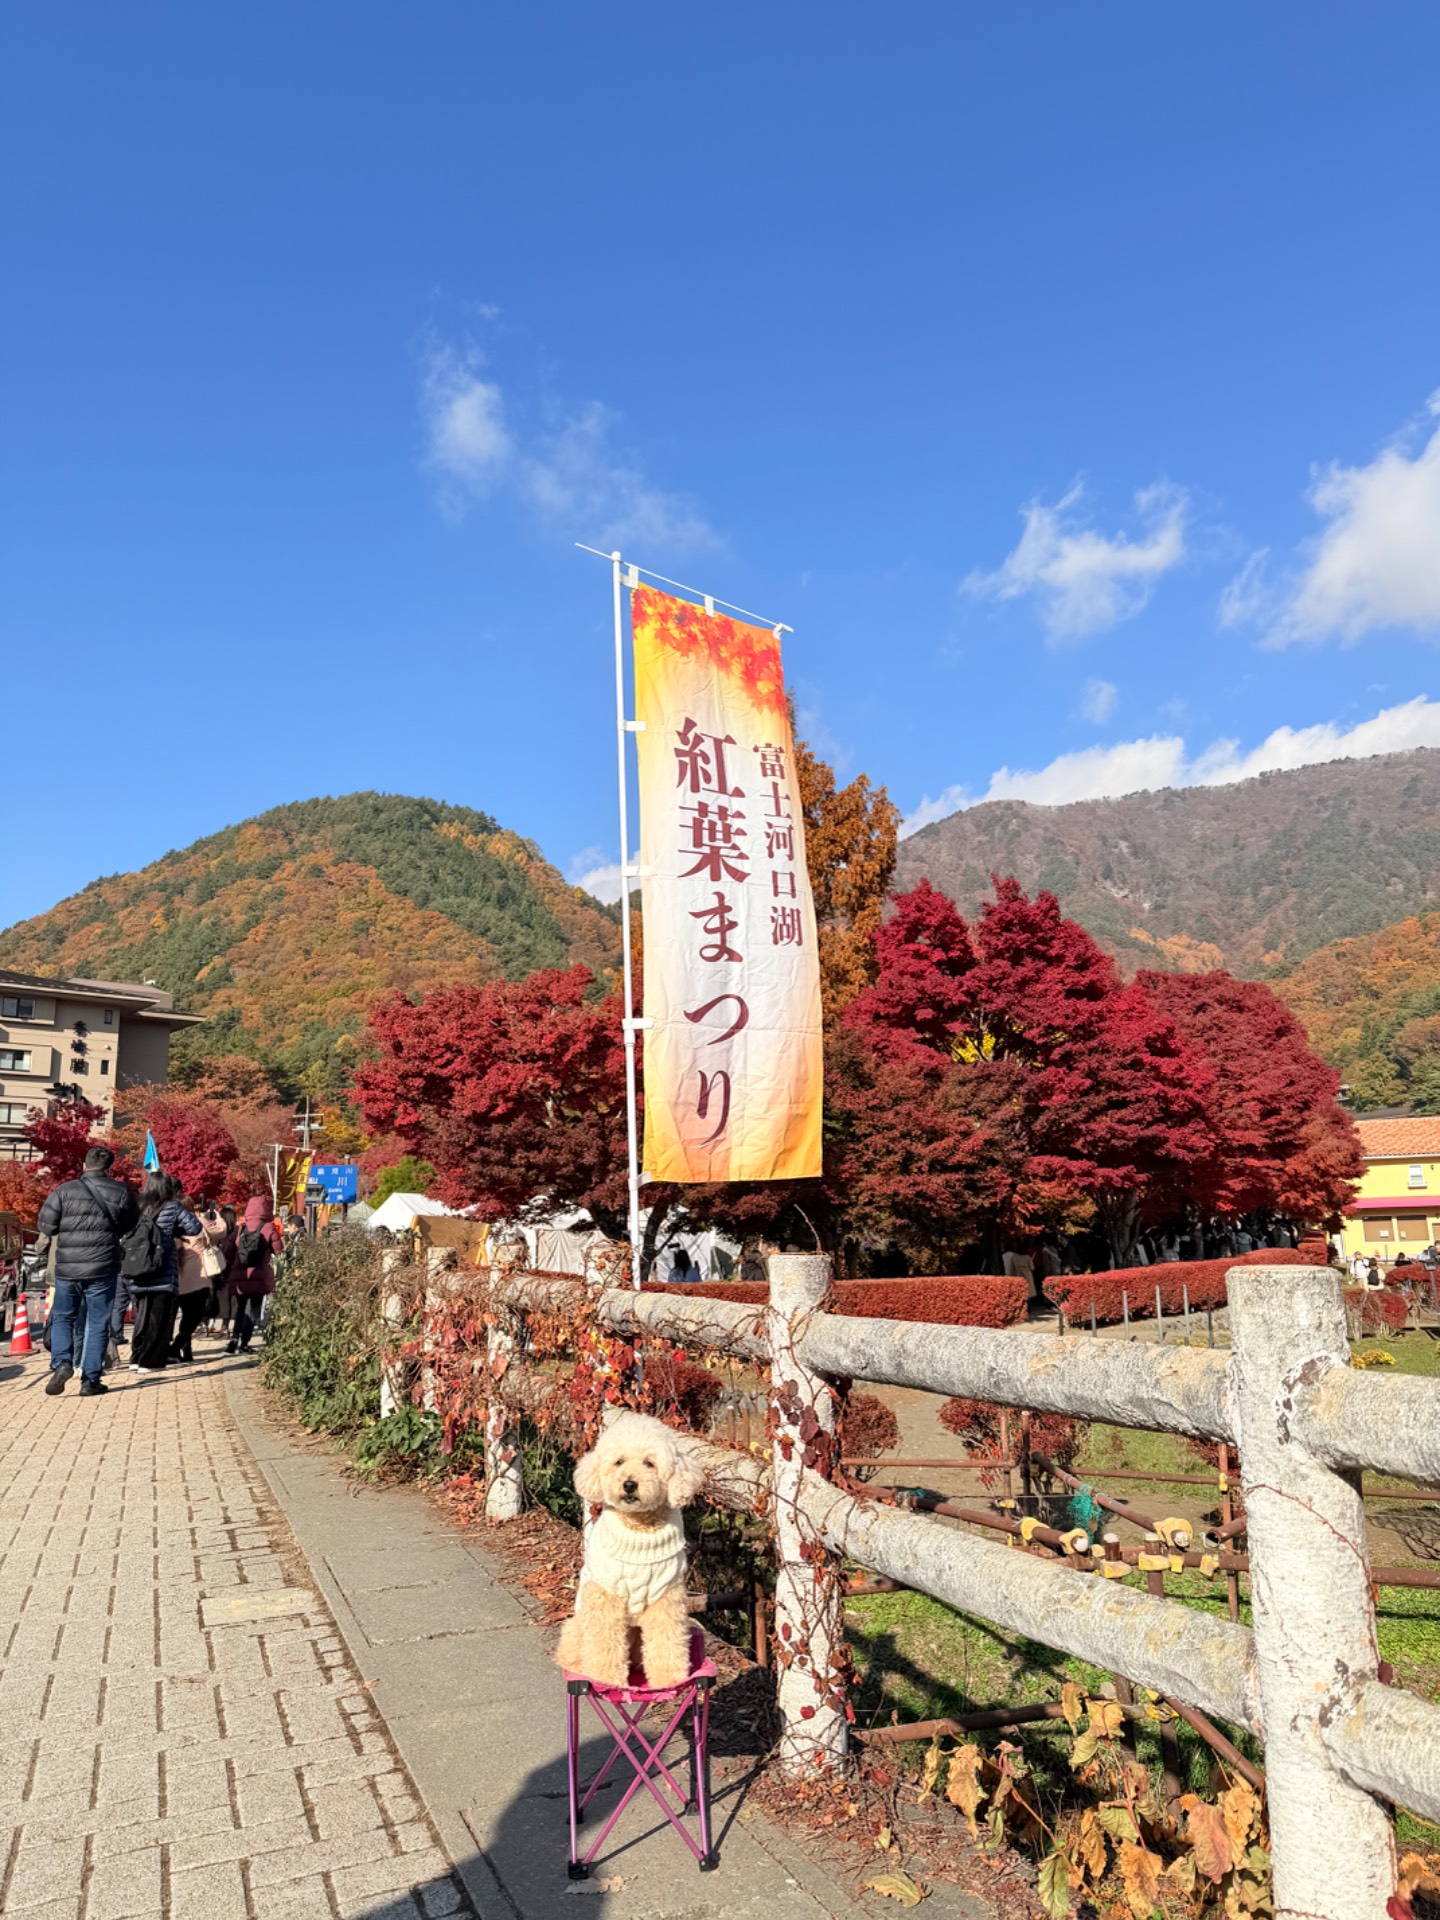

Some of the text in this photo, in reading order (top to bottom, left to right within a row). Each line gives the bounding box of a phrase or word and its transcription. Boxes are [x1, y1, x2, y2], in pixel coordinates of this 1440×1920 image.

[675, 717, 750, 1145] 紅葉まつり
[753, 742, 804, 948] 富士河口湖
